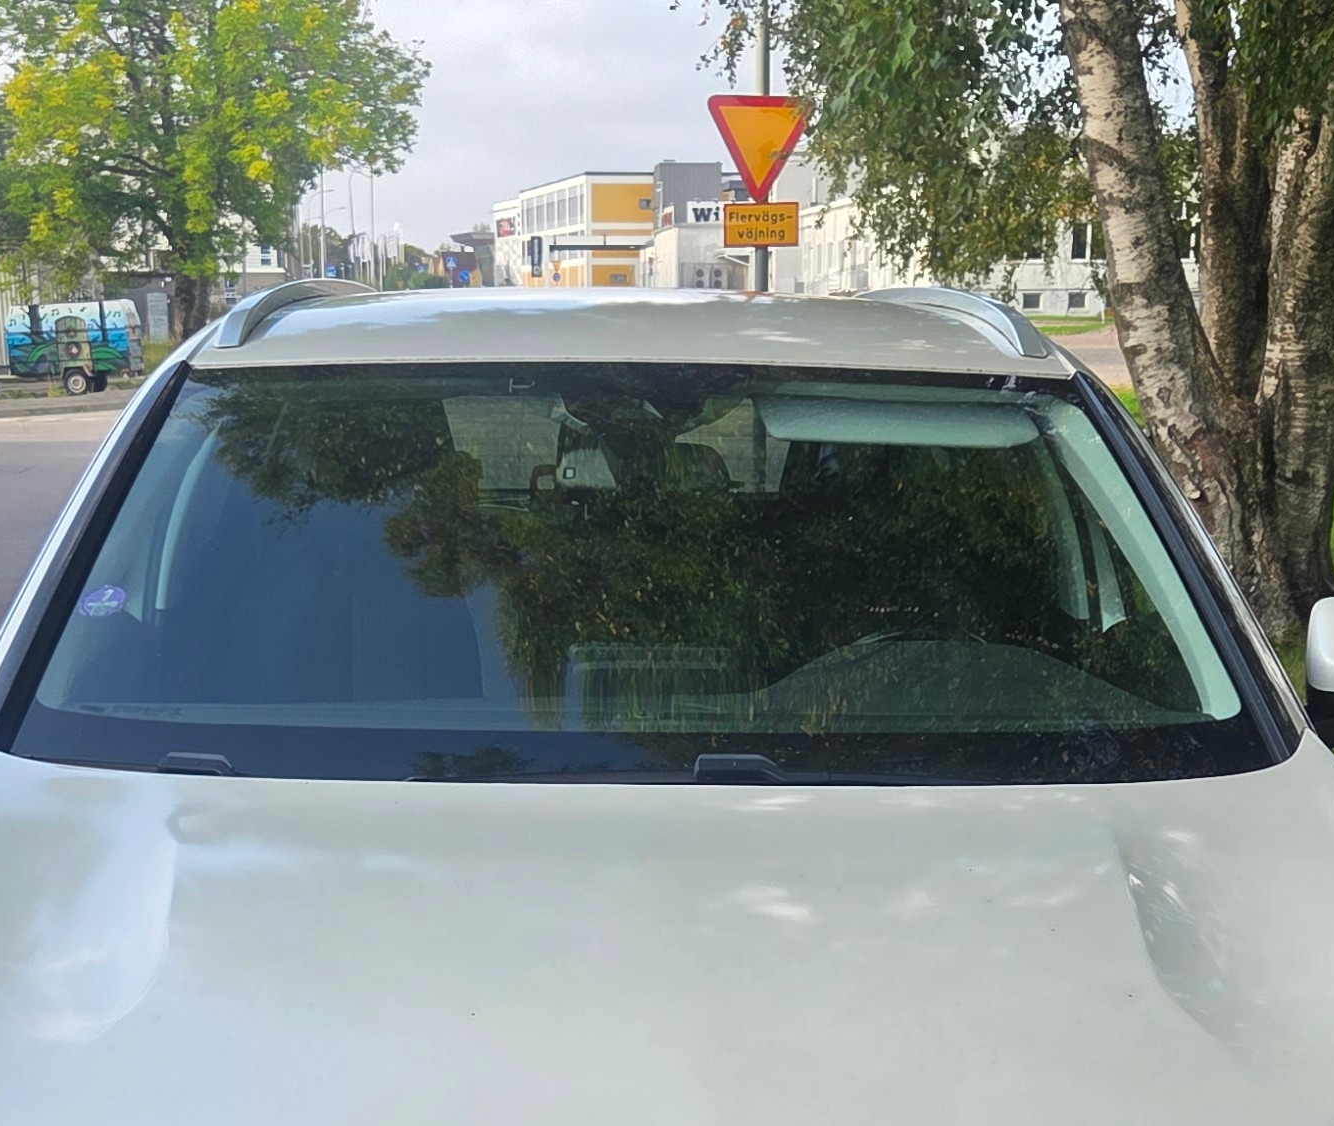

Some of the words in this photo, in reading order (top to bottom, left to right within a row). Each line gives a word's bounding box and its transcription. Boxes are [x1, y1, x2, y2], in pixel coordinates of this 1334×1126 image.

[692, 206, 720, 222] Wi
[729, 210, 793, 224] Flervägs-
[737, 226, 786, 241] väjning
